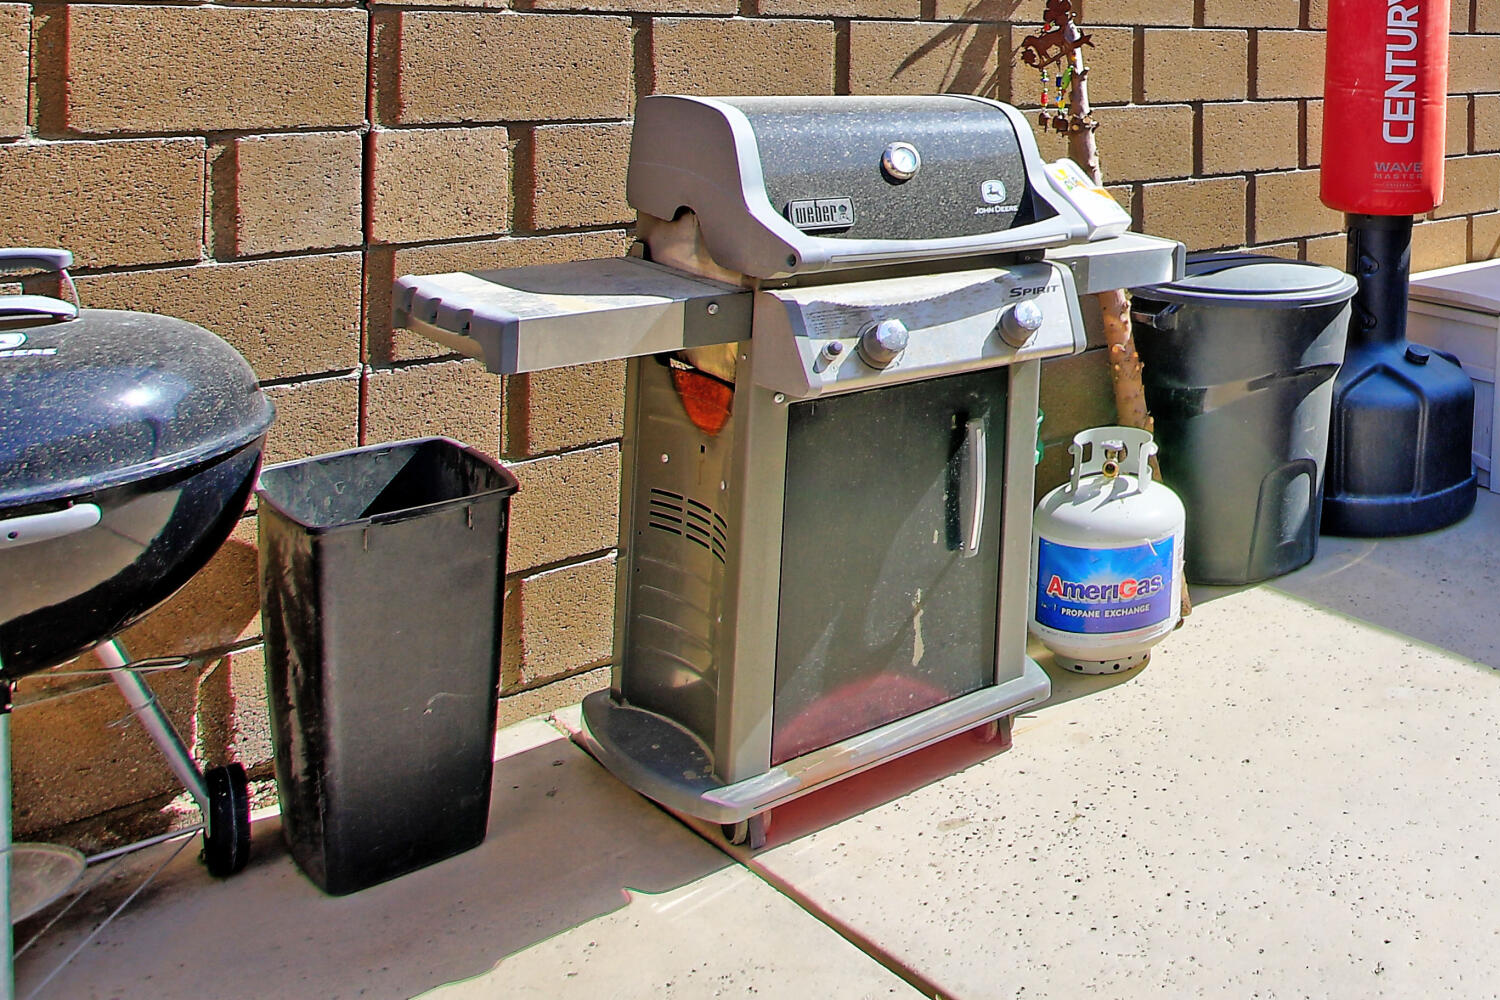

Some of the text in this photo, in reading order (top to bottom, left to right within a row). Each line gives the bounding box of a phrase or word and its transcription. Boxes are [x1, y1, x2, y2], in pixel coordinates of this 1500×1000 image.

[1374, 161, 1424, 172] WAVE
[795, 199, 837, 224] weber
[1009, 284, 1059, 298] SPIRIT
[1046, 574, 1164, 602] AmeriGas
[1061, 603, 1151, 618] PROPANE EXCHANGE
